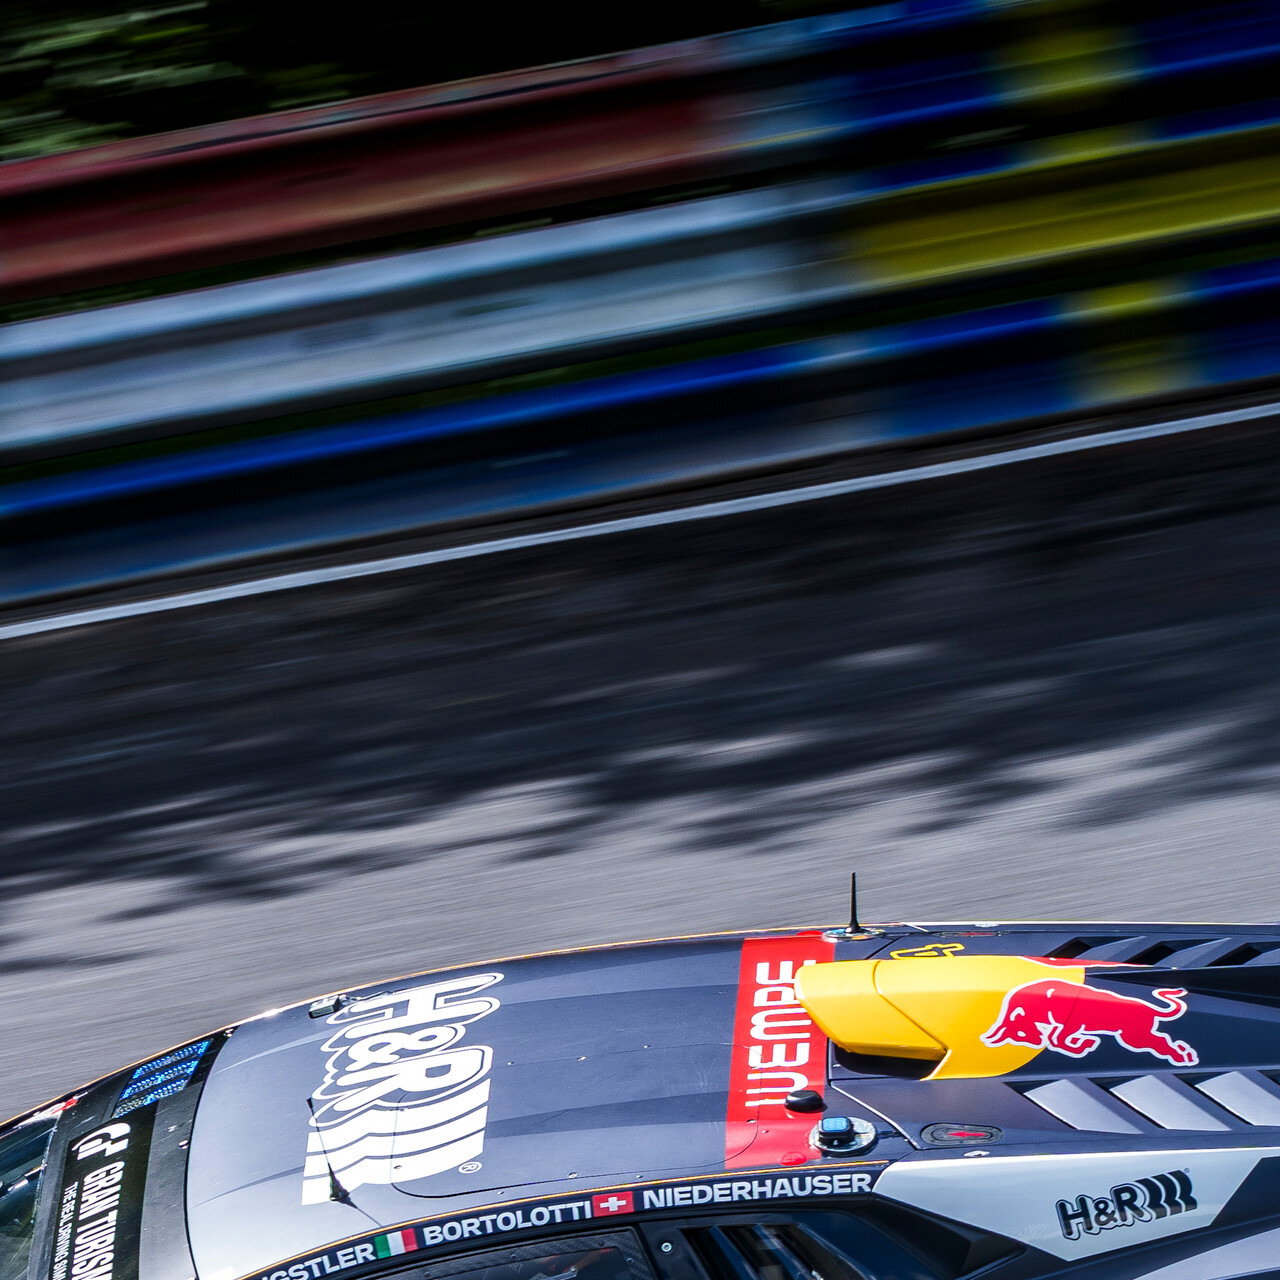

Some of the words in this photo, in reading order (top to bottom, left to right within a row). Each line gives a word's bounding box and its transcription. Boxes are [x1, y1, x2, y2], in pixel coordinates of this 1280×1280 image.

[308, 972, 504, 1127] H&R
[64, 1181, 78, 1203] THE
[78, 1161, 125, 1221] GRAN
[642, 1172, 873, 1210] NIEDERHAUSER
[1055, 1182, 1152, 1240] H&R
[59, 1201, 75, 1227] REAL
[423, 1201, 594, 1247] BORTOLOTTI
[54, 1223, 72, 1262] DRIVING
